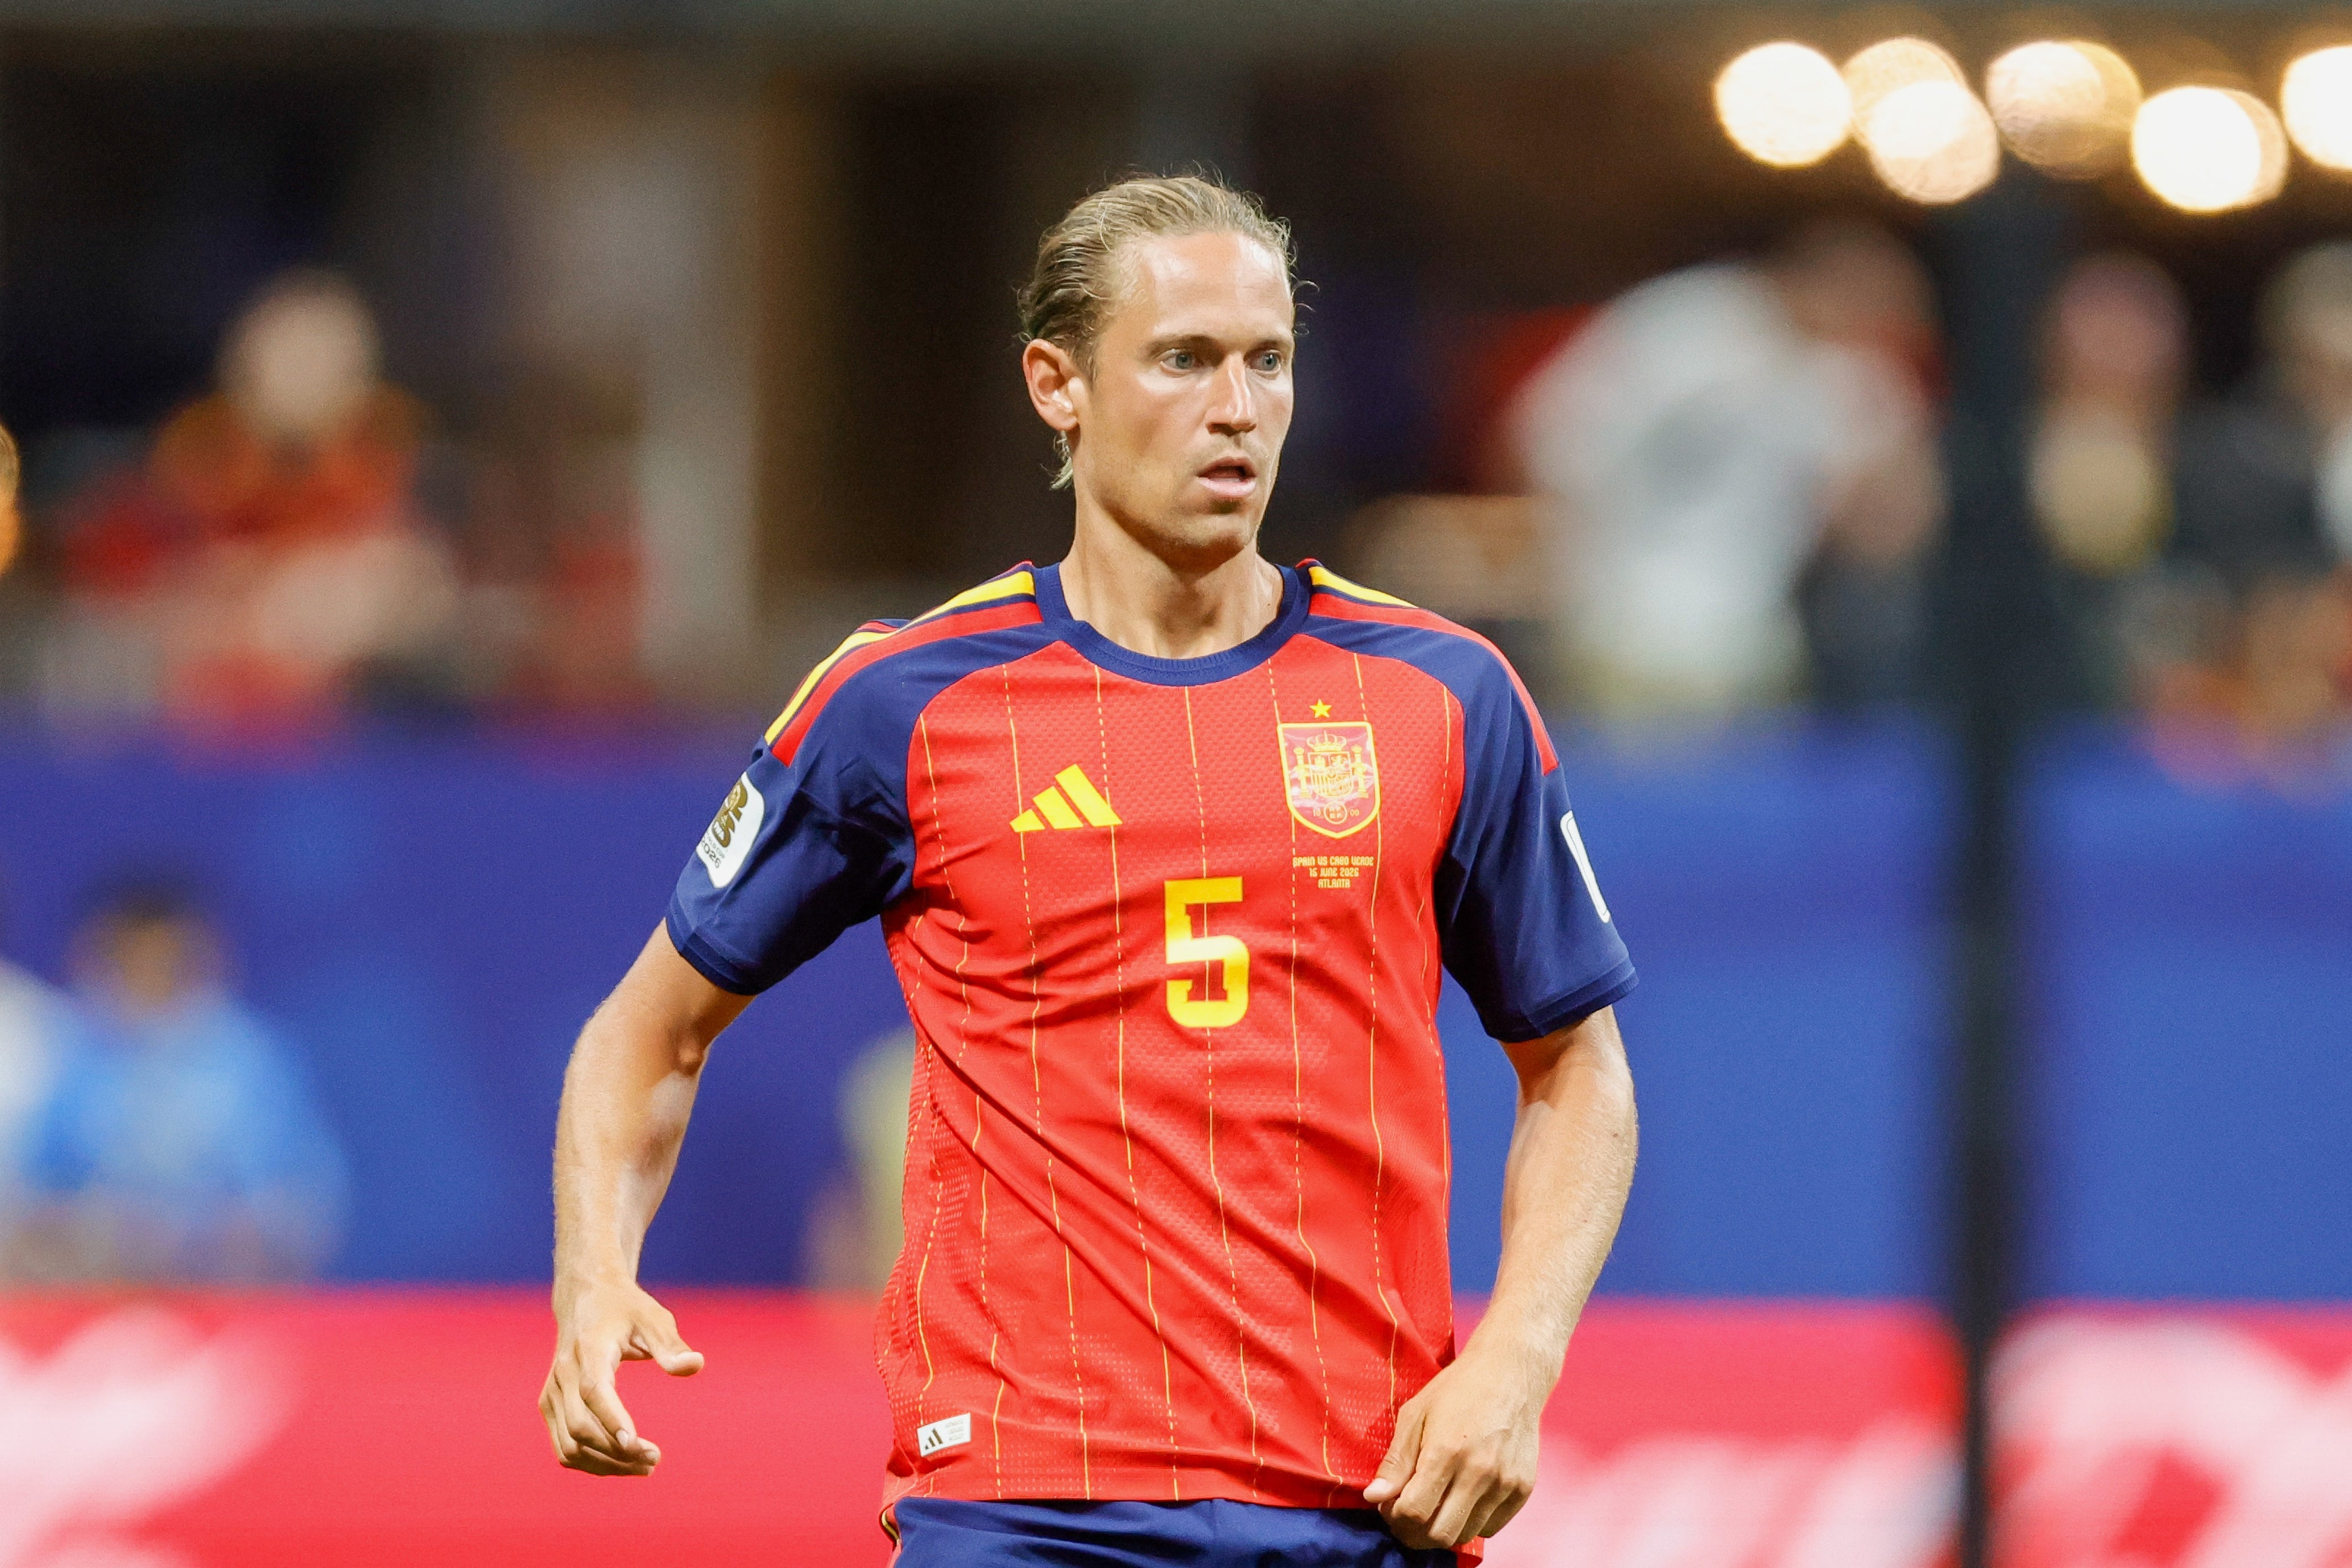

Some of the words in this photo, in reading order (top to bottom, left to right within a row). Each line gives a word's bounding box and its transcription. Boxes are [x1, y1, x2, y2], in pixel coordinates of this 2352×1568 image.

[701, 836, 721, 869] 2026
[1293, 857, 1315, 866] SPAIN
[1330, 856, 1349, 866] CABO
[1351, 856, 1374, 866] VERDE
[1320, 867, 1337, 877] JUNE
[1339, 867, 1359, 877] 2026
[1318, 879, 1350, 888] ATLANTA
[1164, 876, 1250, 1027] 5
